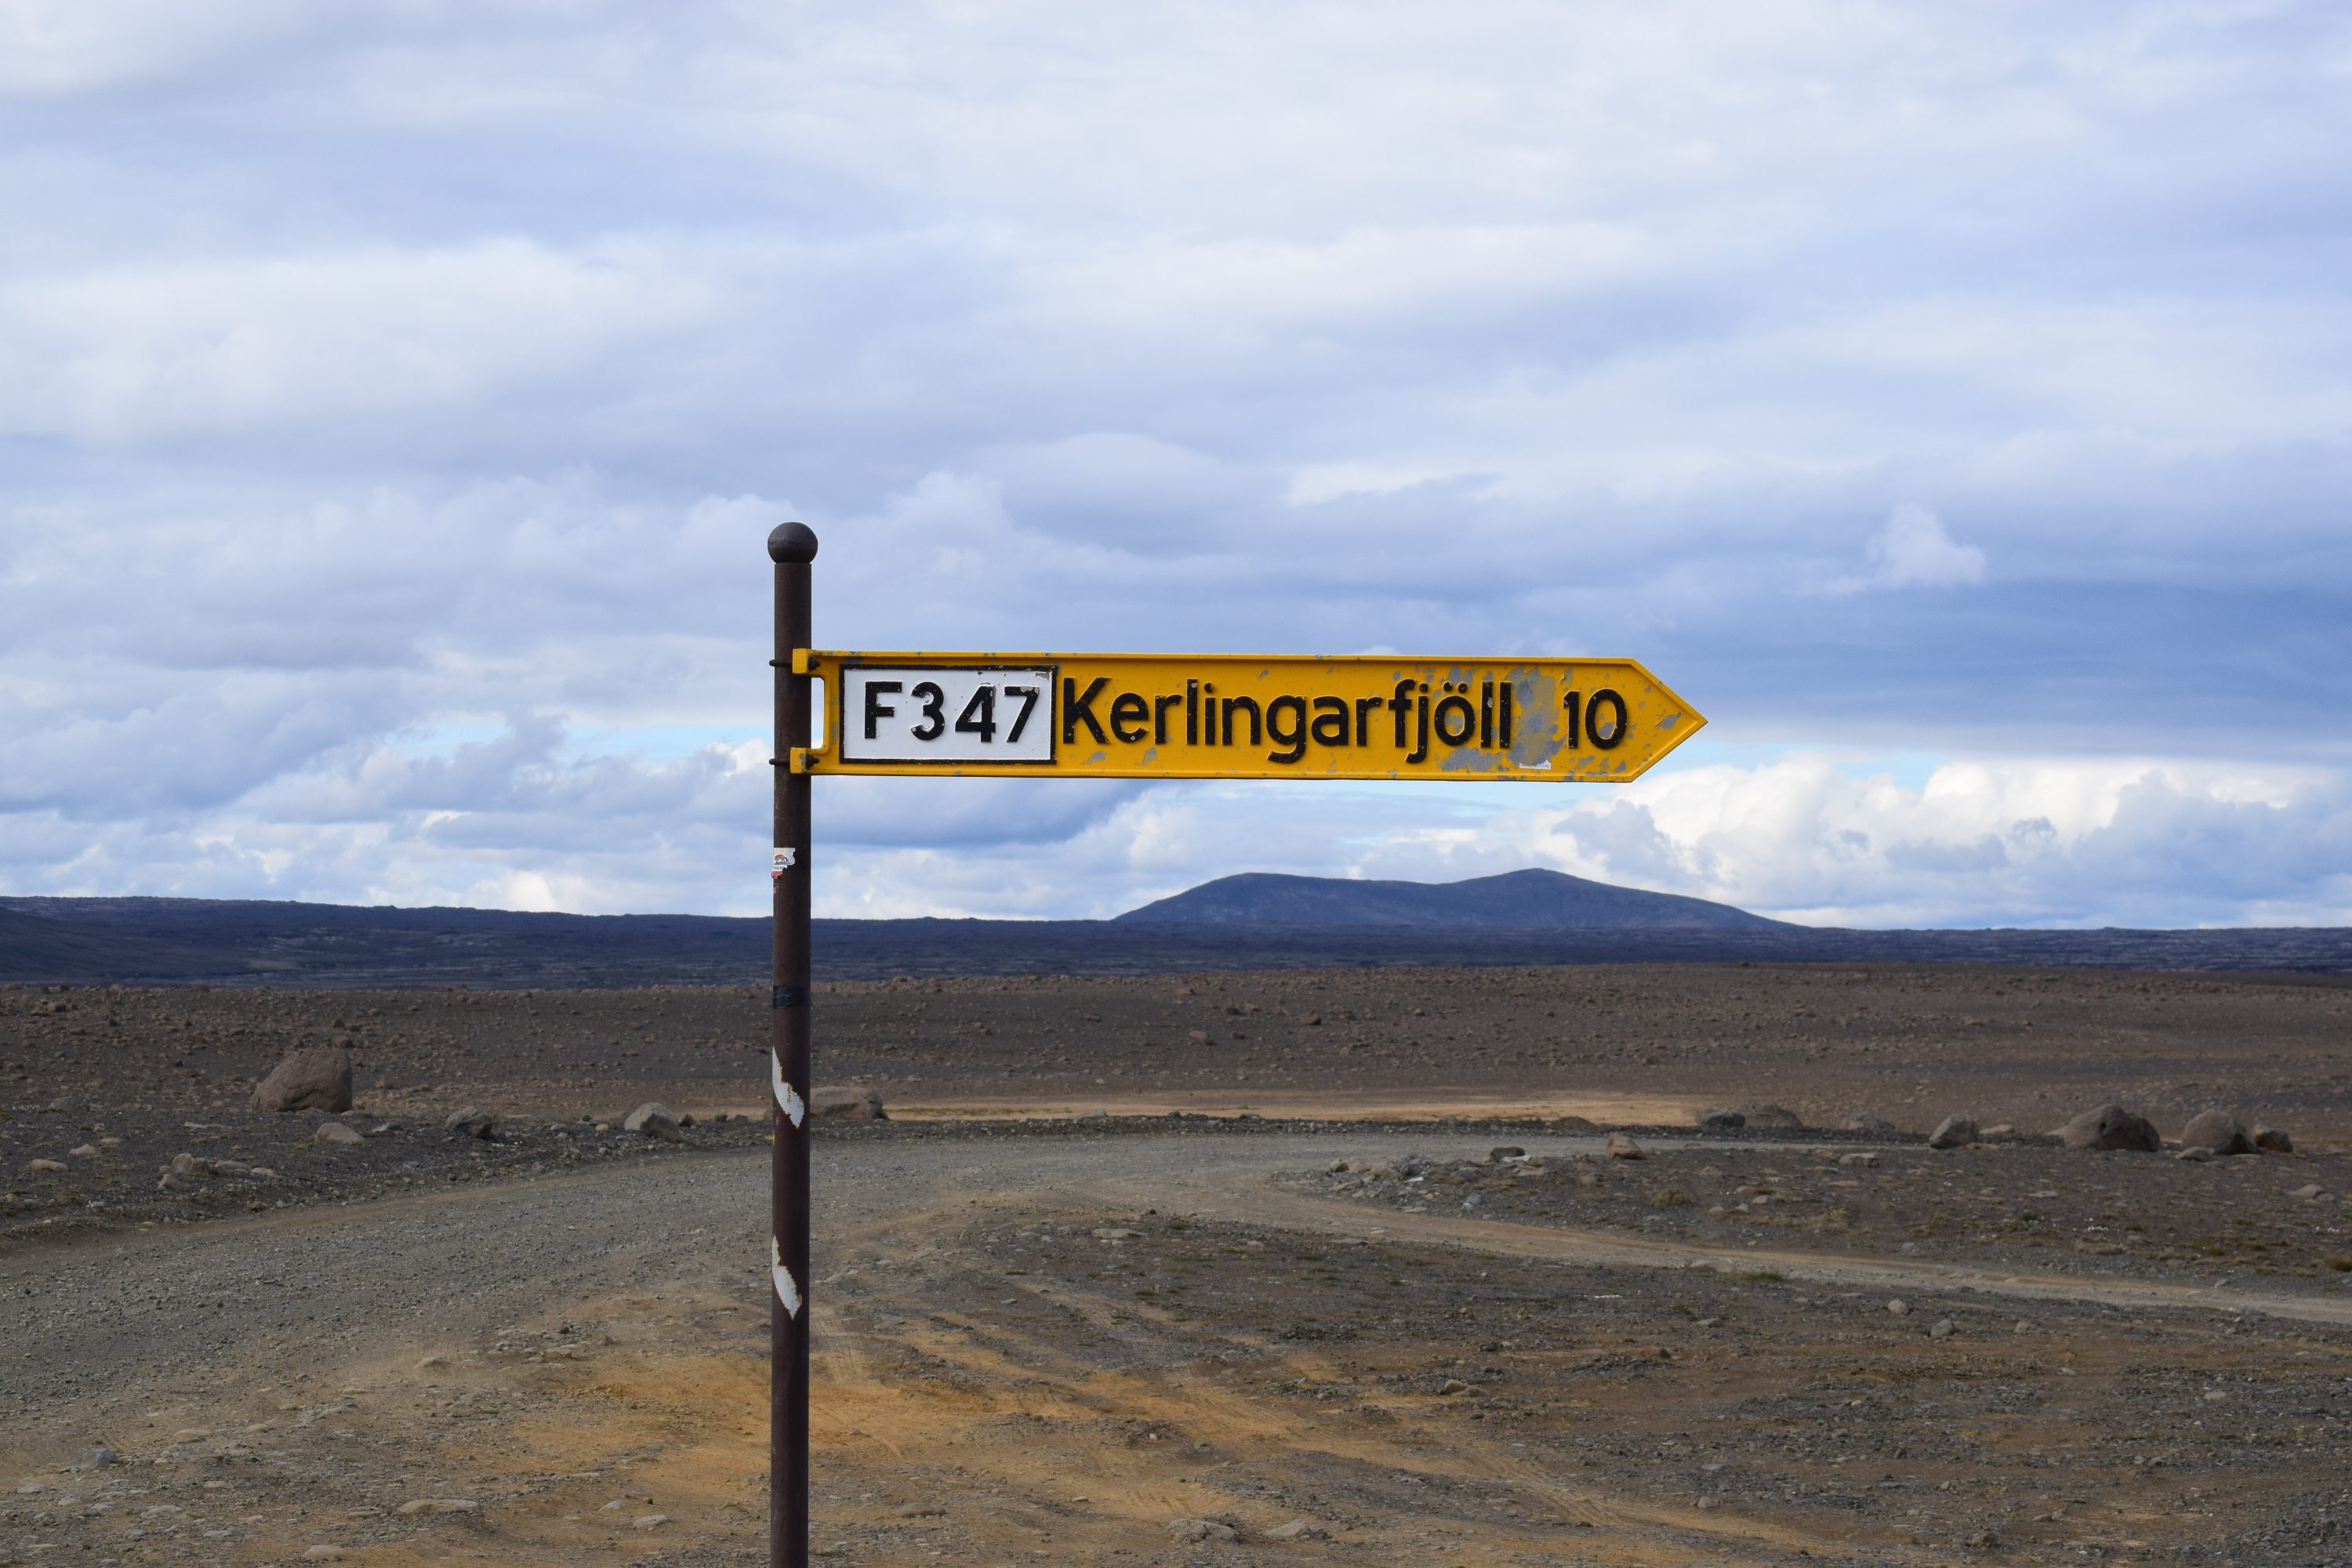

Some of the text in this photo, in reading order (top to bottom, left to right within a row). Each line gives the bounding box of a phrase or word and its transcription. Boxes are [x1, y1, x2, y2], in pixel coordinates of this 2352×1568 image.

[864, 677, 1628, 764] F347 Kerlingarfjöll 10
